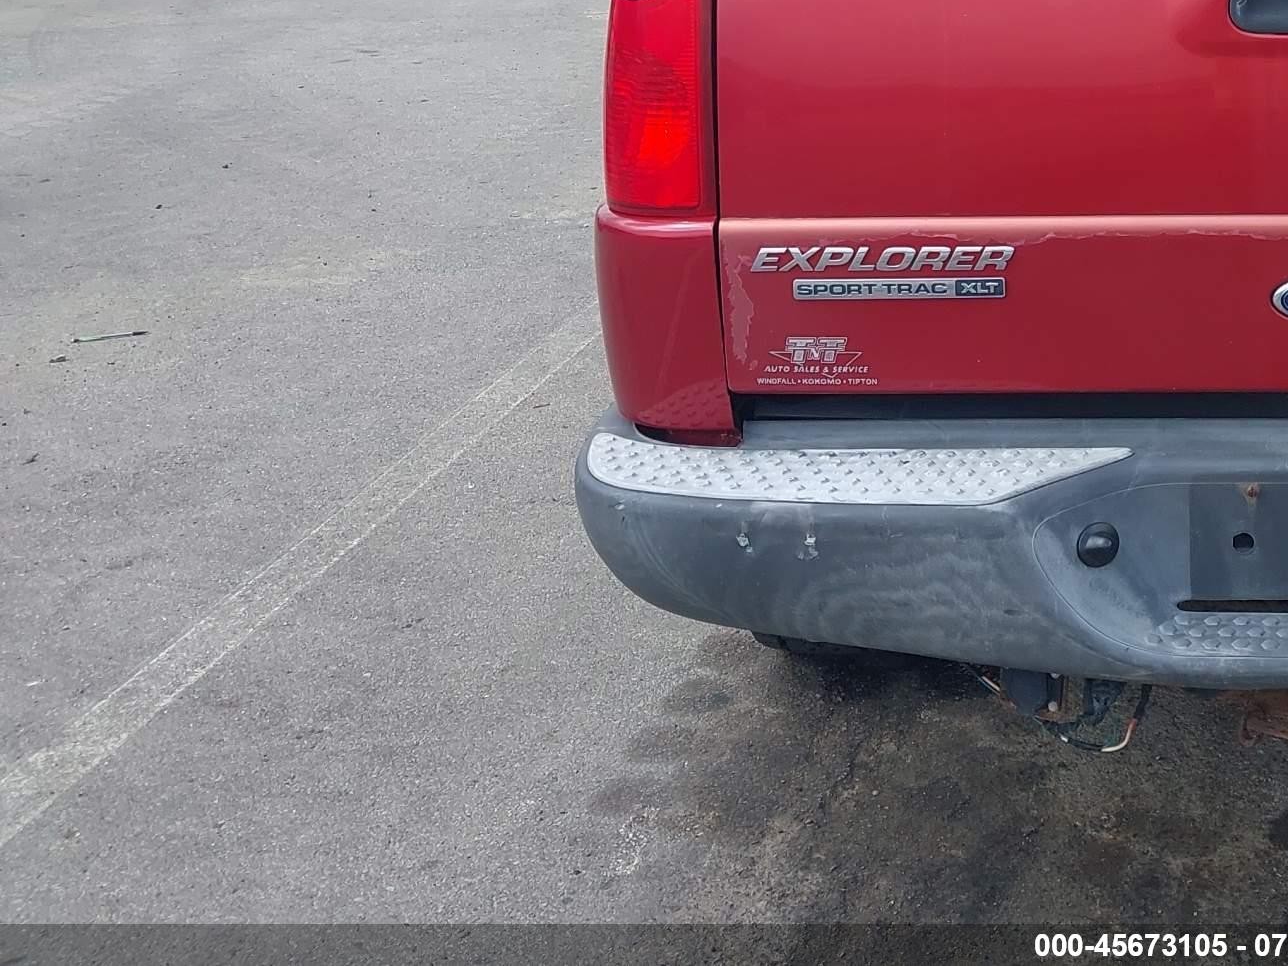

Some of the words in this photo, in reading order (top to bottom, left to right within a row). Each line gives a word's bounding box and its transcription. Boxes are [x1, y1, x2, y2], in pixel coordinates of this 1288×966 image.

[750, 245, 1016, 272] EXPLORER
[796, 282, 878, 296] SPORT
[880, 282, 948, 295] TRAC
[959, 281, 1000, 294] XLT
[763, 365, 790, 373] AUTO
[793, 365, 820, 373] SALES
[822, 365, 829, 373] &
[832, 365, 869, 373] SERVICE
[756, 377, 797, 385] WINDFALL
[801, 377, 842, 385] KOKOMO
[847, 377, 878, 385] TIPTON
